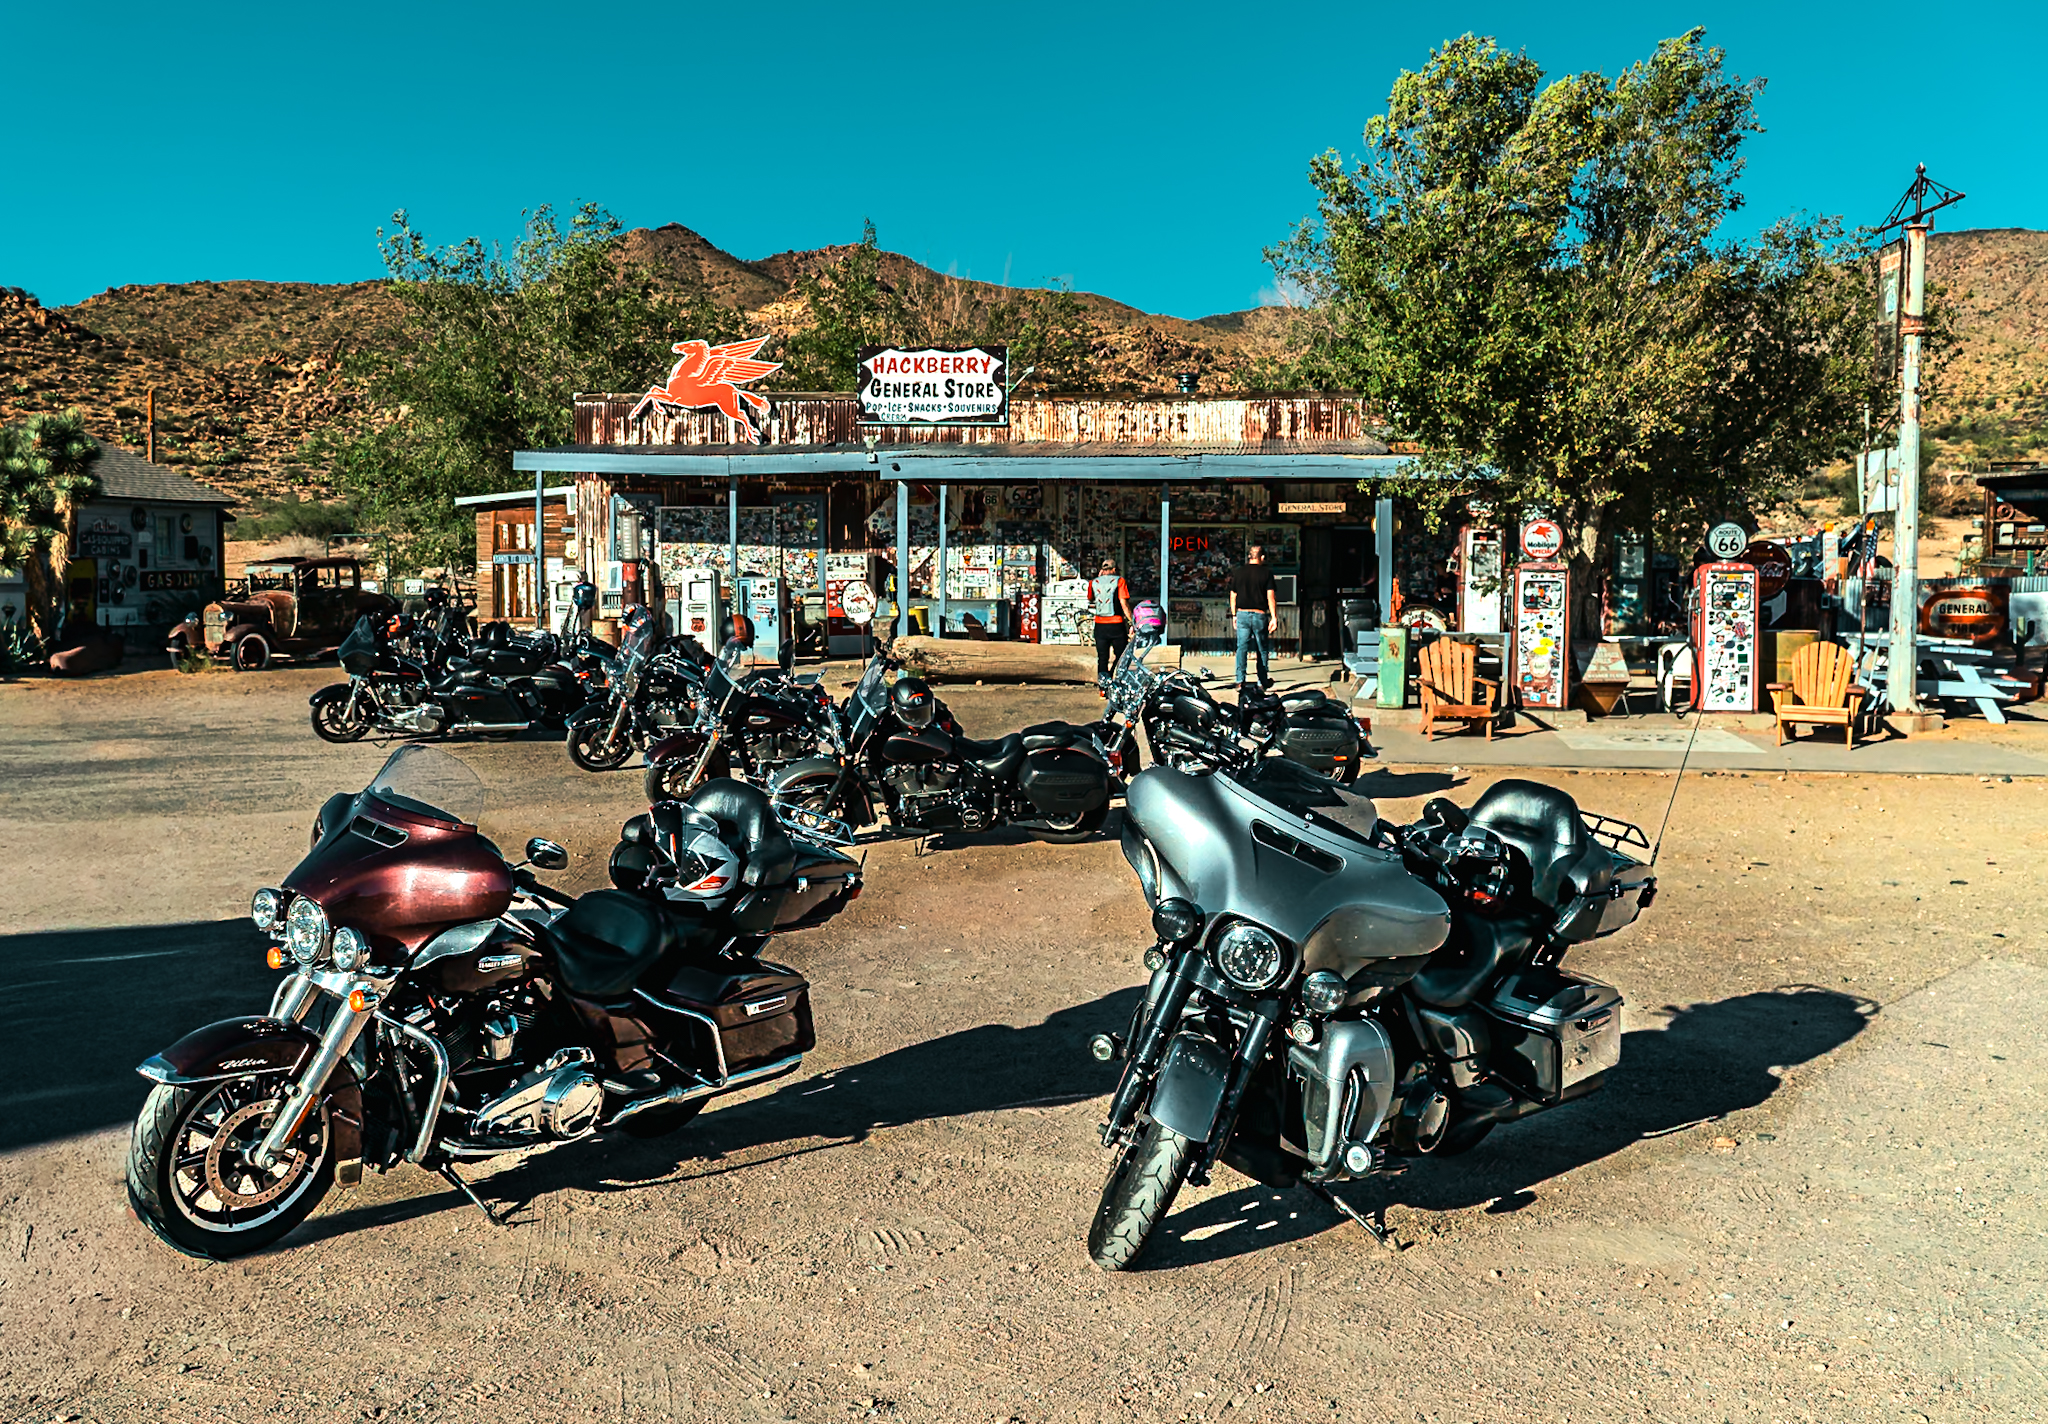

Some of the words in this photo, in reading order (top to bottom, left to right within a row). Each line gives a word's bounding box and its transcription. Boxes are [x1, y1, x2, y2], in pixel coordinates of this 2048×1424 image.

[873, 355, 991, 374] HACKBERRY
[870, 377, 939, 398] GENERAL
[944, 378, 994, 398] STORE
[866, 401, 883, 412] POP
[888, 402, 902, 412] ICE
[908, 402, 942, 412] SNACKS
[948, 402, 997, 413] SOUVENIRS
[1281, 504, 1317, 512] GENERAL
[90, 545, 121, 555] CABINS
[1527, 541, 1557, 550] Mobilgas
[1718, 537, 1740, 552] 66
[1939, 603, 1990, 614] GENERAL
